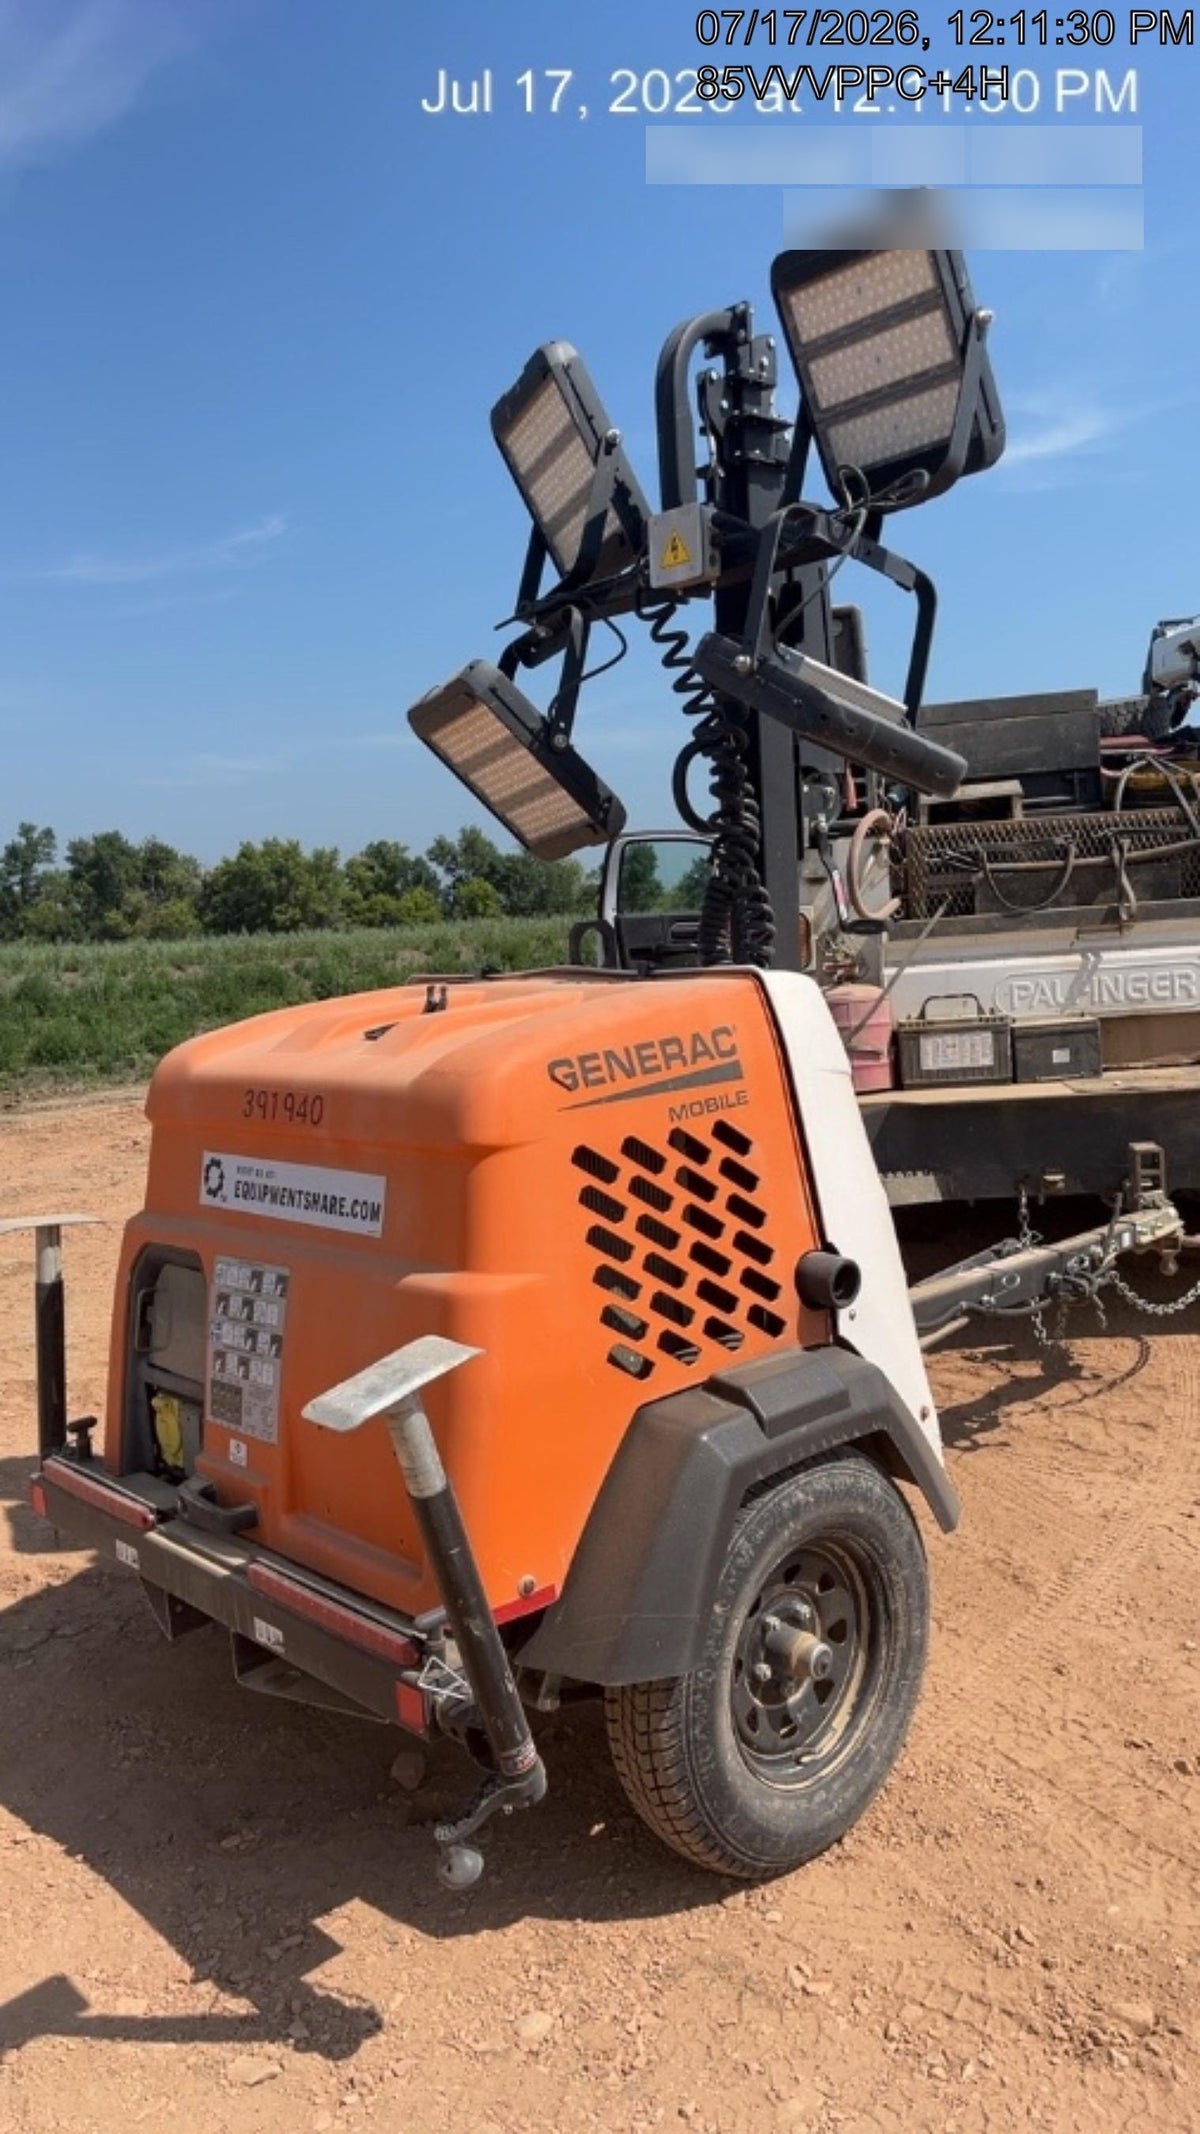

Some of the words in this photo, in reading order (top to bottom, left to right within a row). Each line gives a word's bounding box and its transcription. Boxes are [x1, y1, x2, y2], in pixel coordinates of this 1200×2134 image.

[547, 1026, 737, 1091] GENERAC
[244, 1089, 324, 1125] 391940
[668, 1090, 748, 1122] MOBILE
[234, 1180, 382, 1222] EQUIPMENTSHARE.COM
